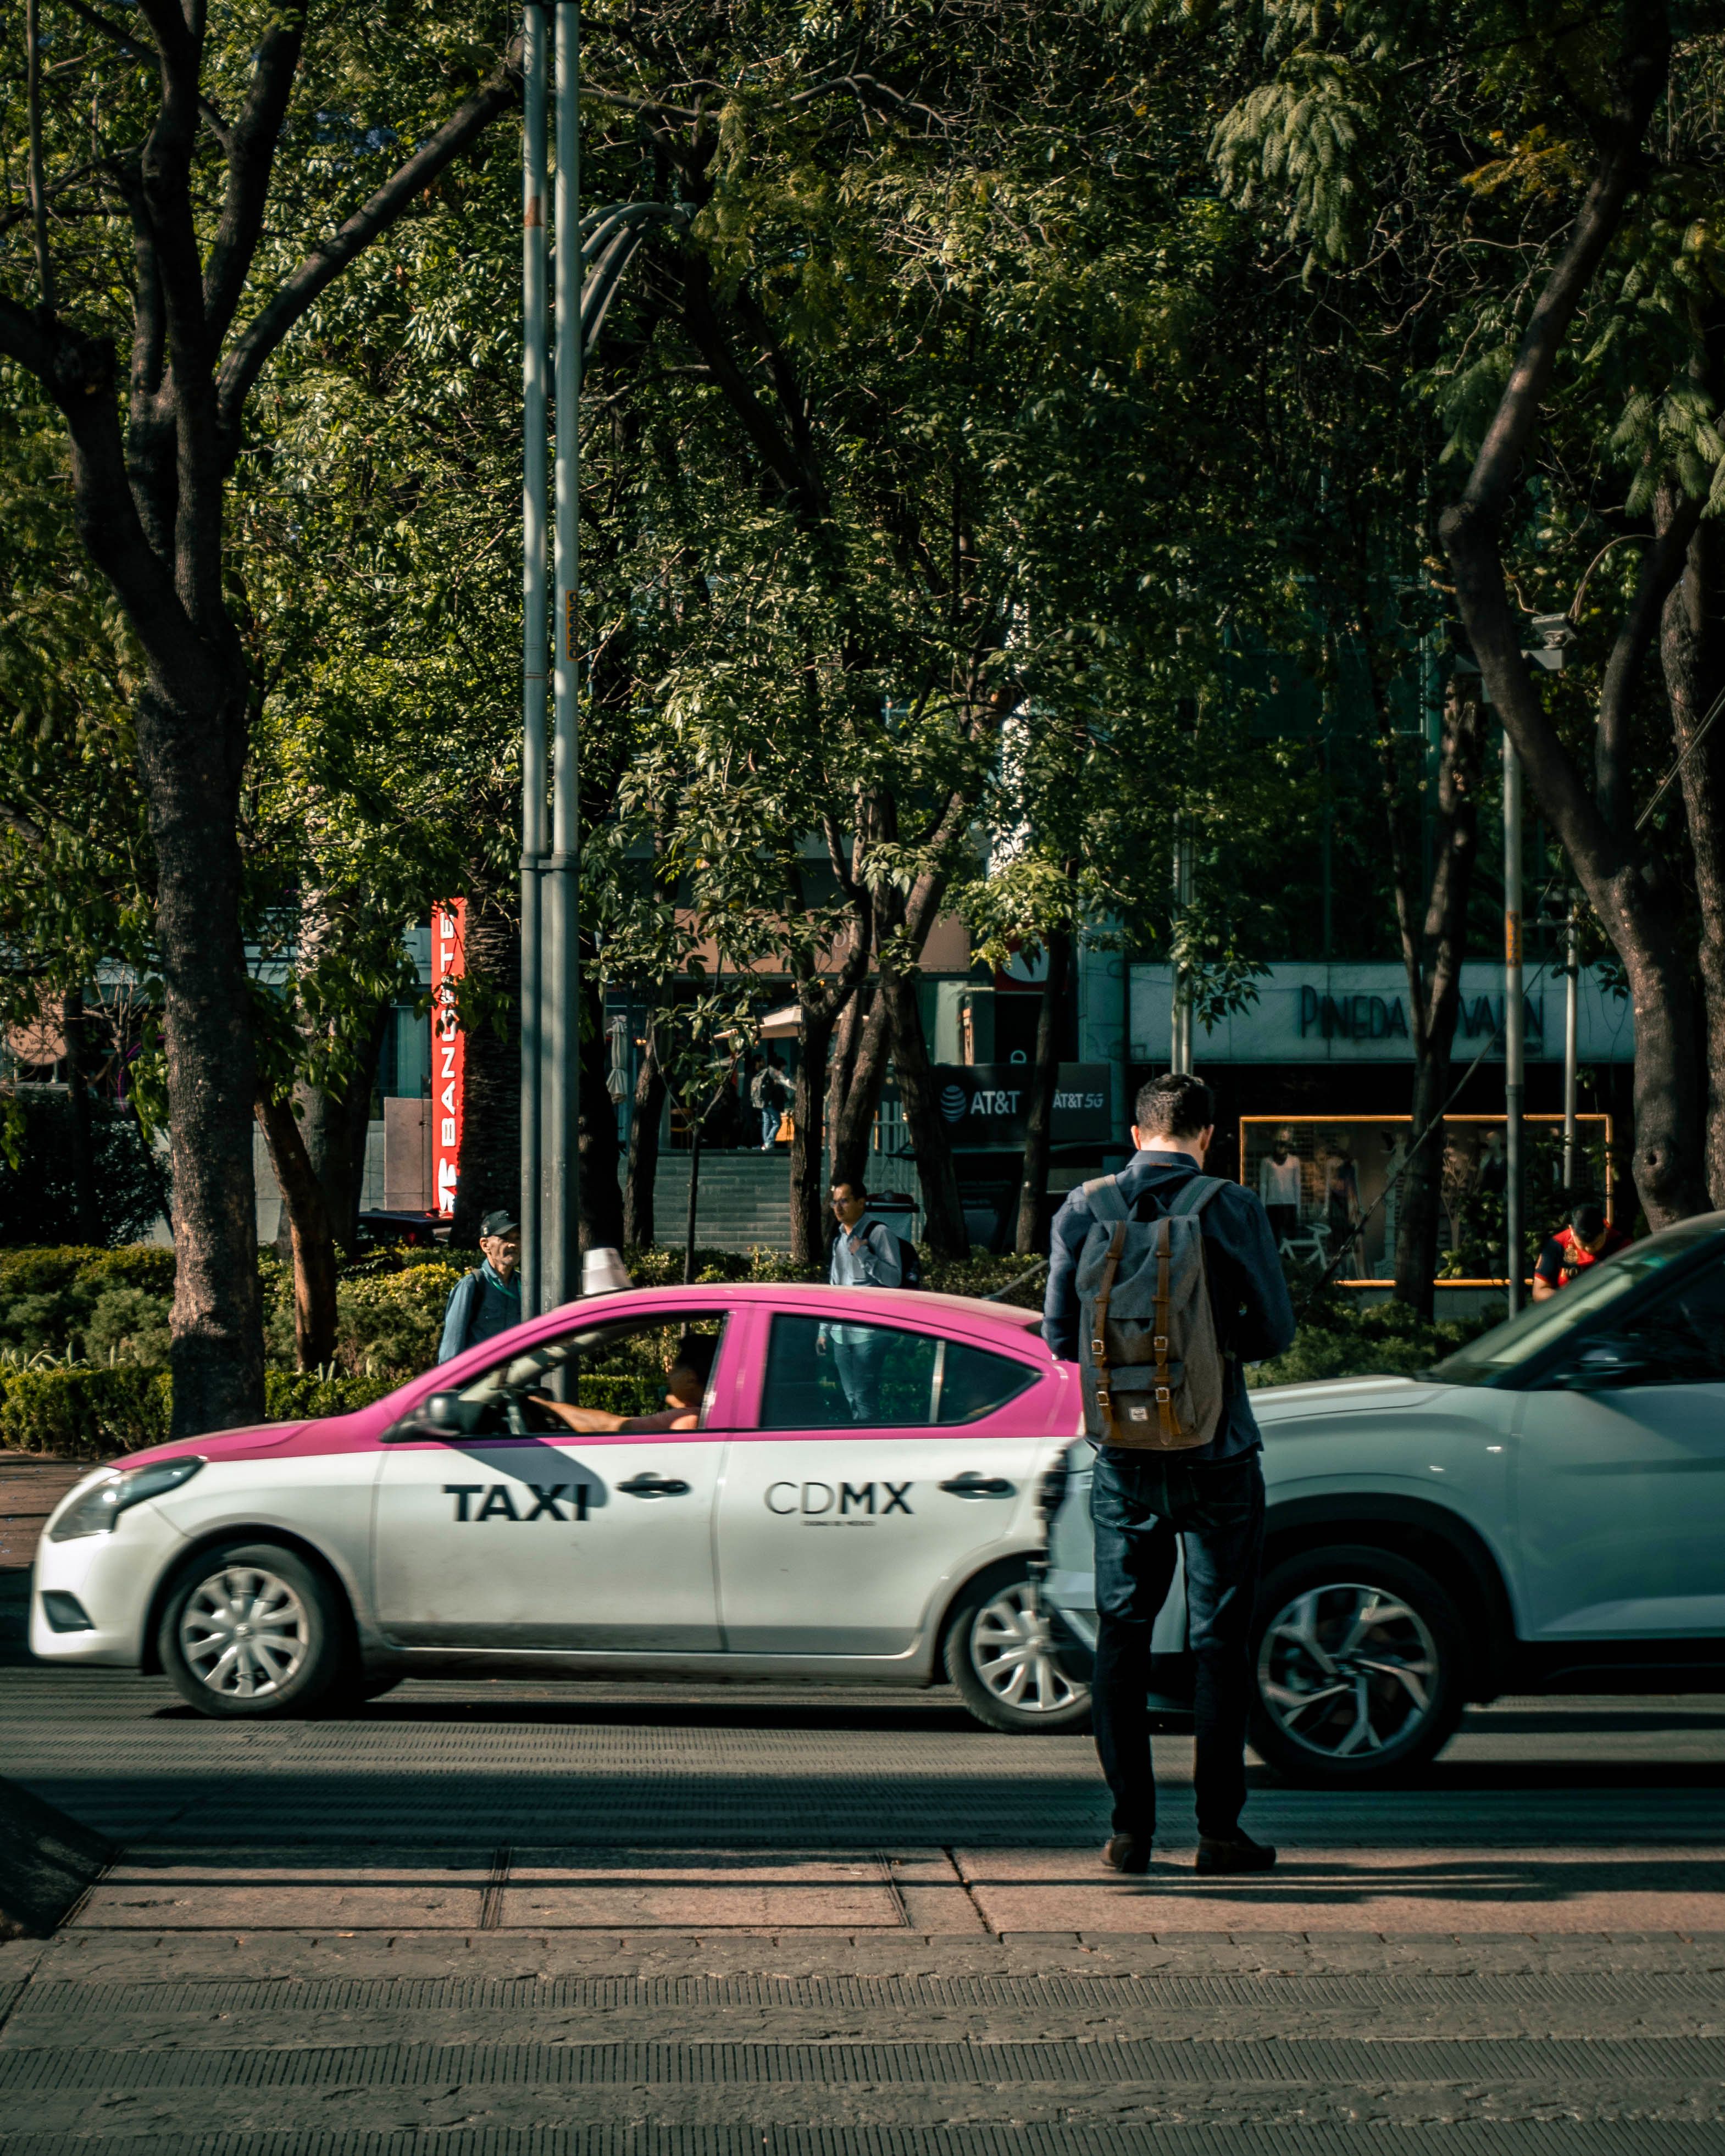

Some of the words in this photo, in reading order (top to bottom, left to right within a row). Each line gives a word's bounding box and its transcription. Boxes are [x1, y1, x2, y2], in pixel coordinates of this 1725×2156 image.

[970, 1091, 1020, 1115] AT&T
[1052, 1093, 1083, 1108] AT&T
[1084, 1093, 1103, 1108] 5G
[443, 1484, 589, 1521] TAXI
[764, 1482, 914, 1515] CDMX
